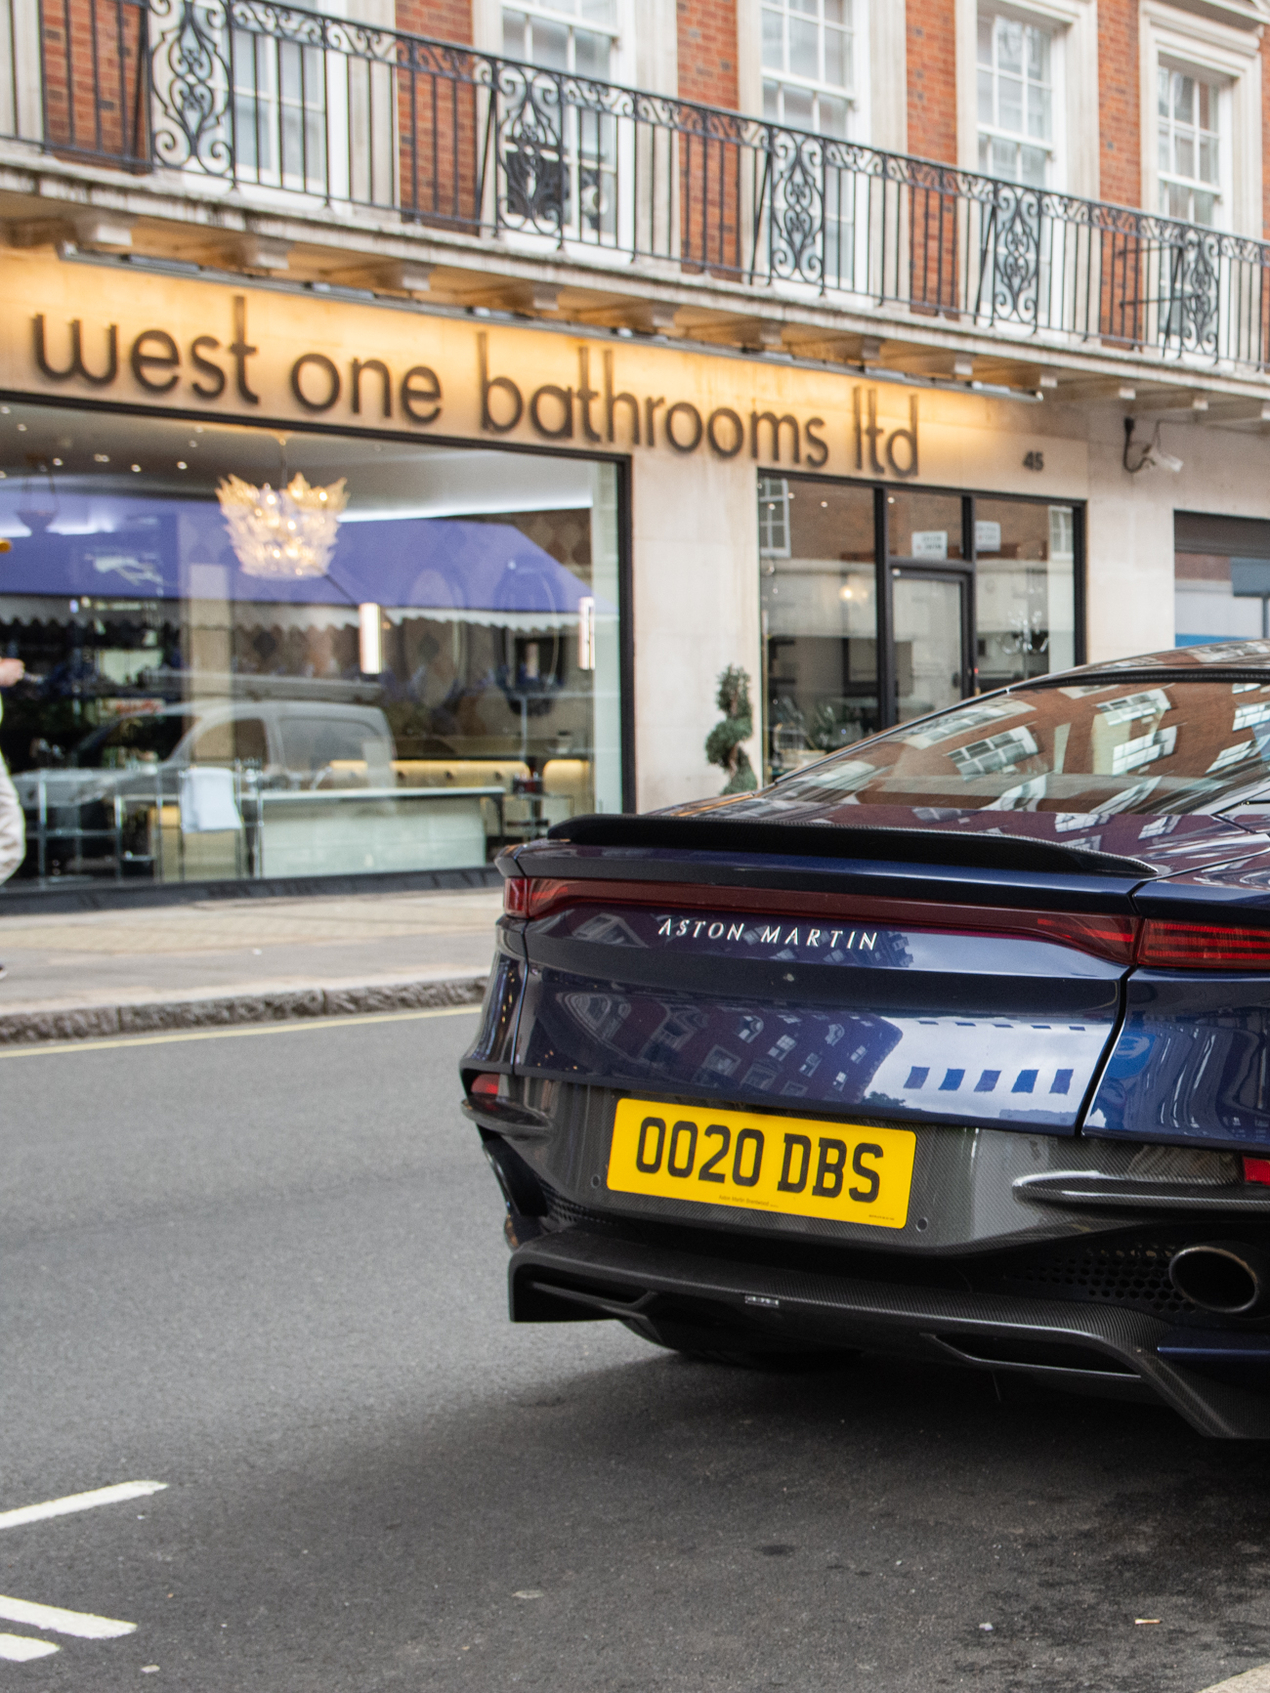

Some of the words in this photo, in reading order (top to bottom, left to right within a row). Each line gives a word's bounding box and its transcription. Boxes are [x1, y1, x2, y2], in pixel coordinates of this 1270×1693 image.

[31, 296, 259, 404] west
[291, 353, 443, 424] one
[477, 331, 829, 469] bathrooms
[852, 385, 919, 477] ltd
[1022, 450, 1045, 472] 45
[658, 918, 745, 942] ASTON
[760, 925, 878, 950] MARTIN
[777, 1132, 884, 1203] DBS
